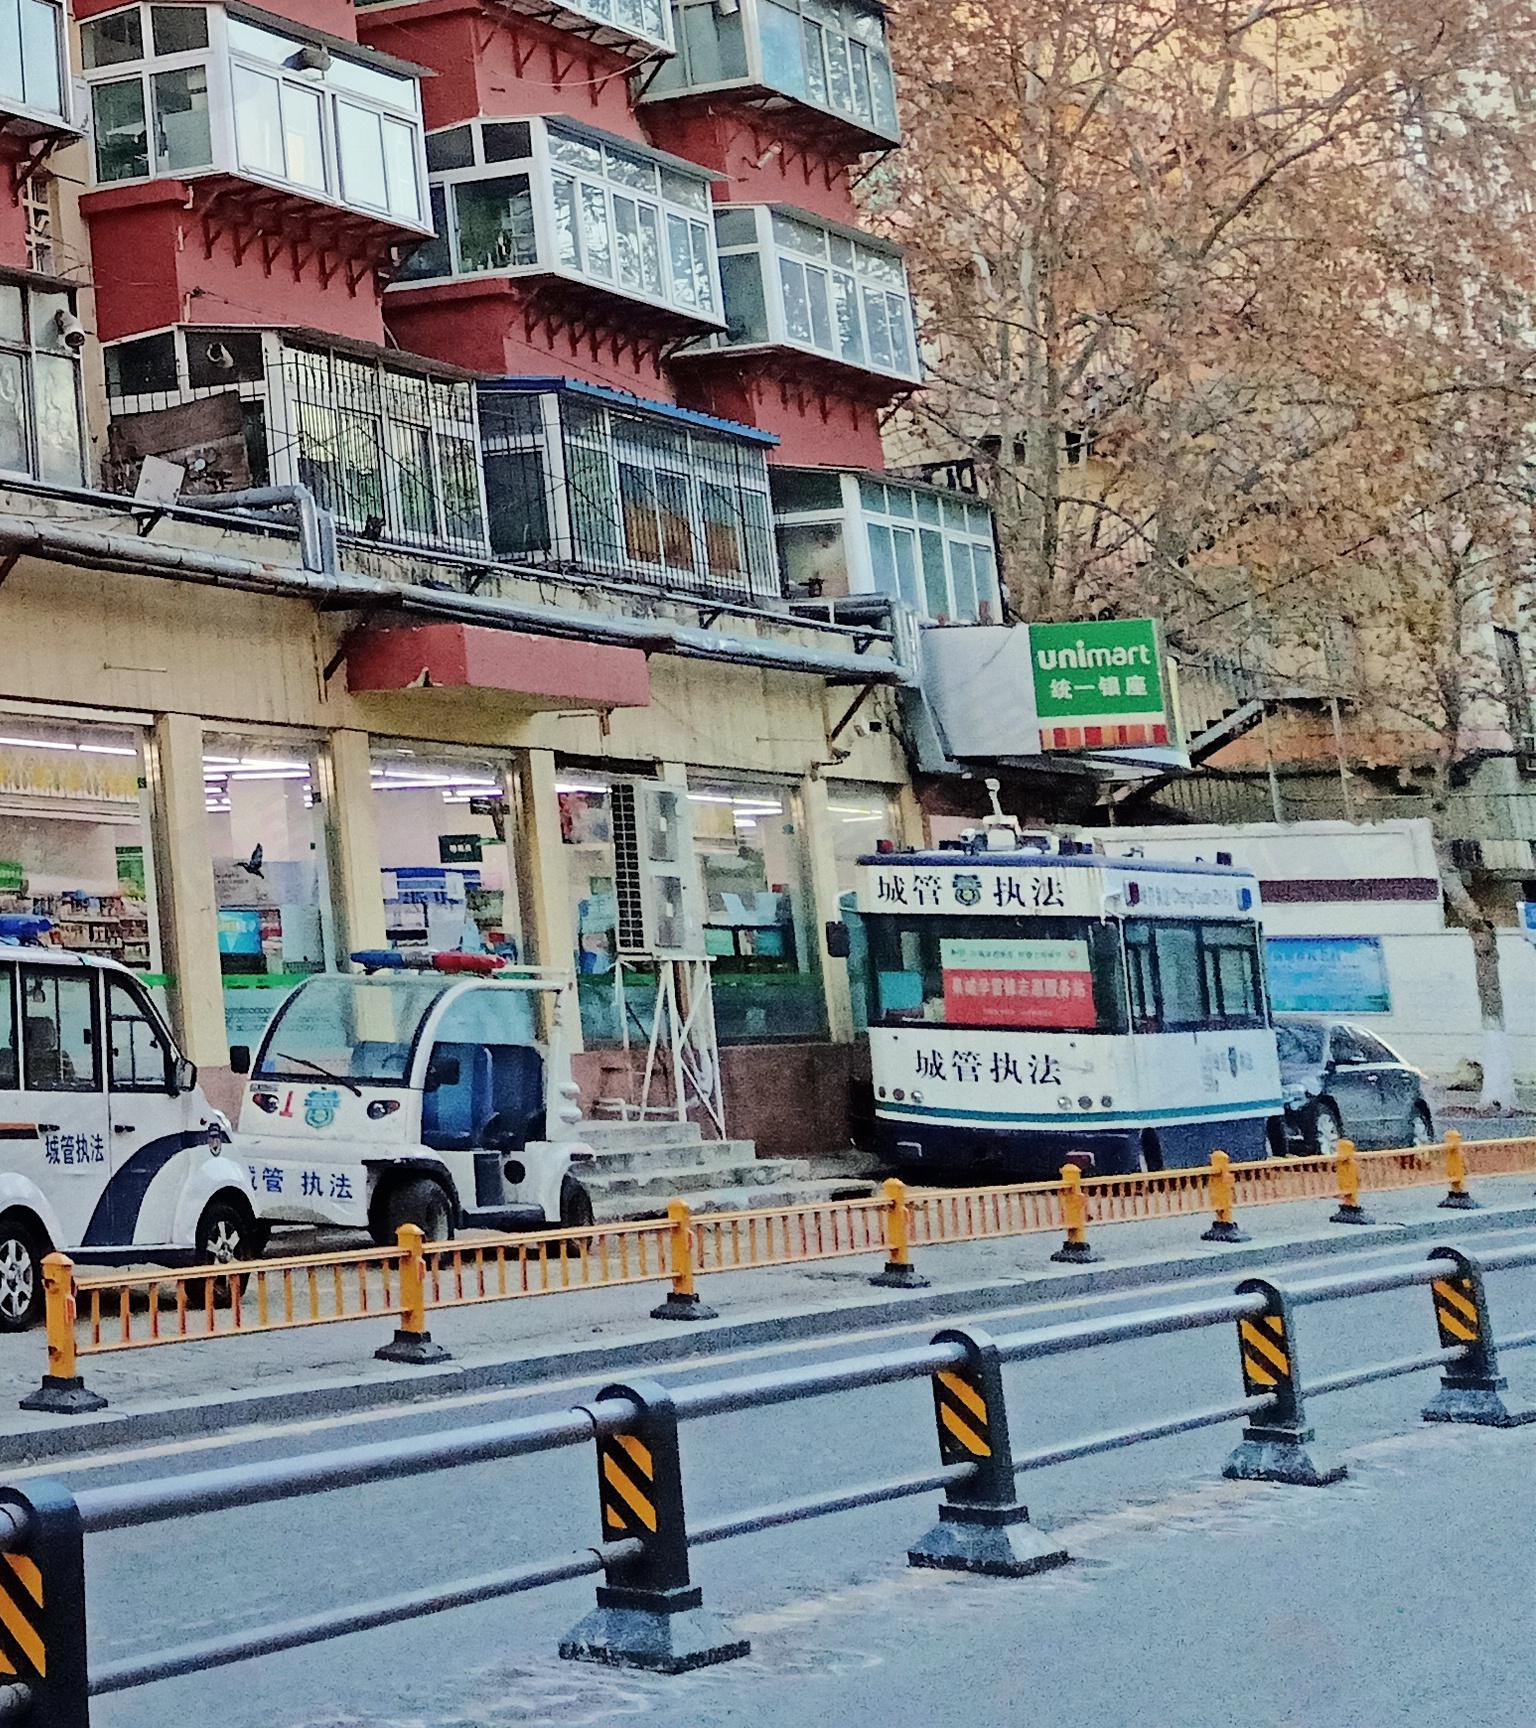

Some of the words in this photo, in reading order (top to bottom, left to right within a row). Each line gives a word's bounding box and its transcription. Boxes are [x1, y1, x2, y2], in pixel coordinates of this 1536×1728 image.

[1037, 639, 1151, 671] unimart
[1049, 675, 1148, 700] 统一银座
[877, 874, 943, 907] 城管
[993, 876, 1066, 908] 执法
[914, 1048, 1063, 1087] 城管执法
[45, 1134, 105, 1164] 城管执法
